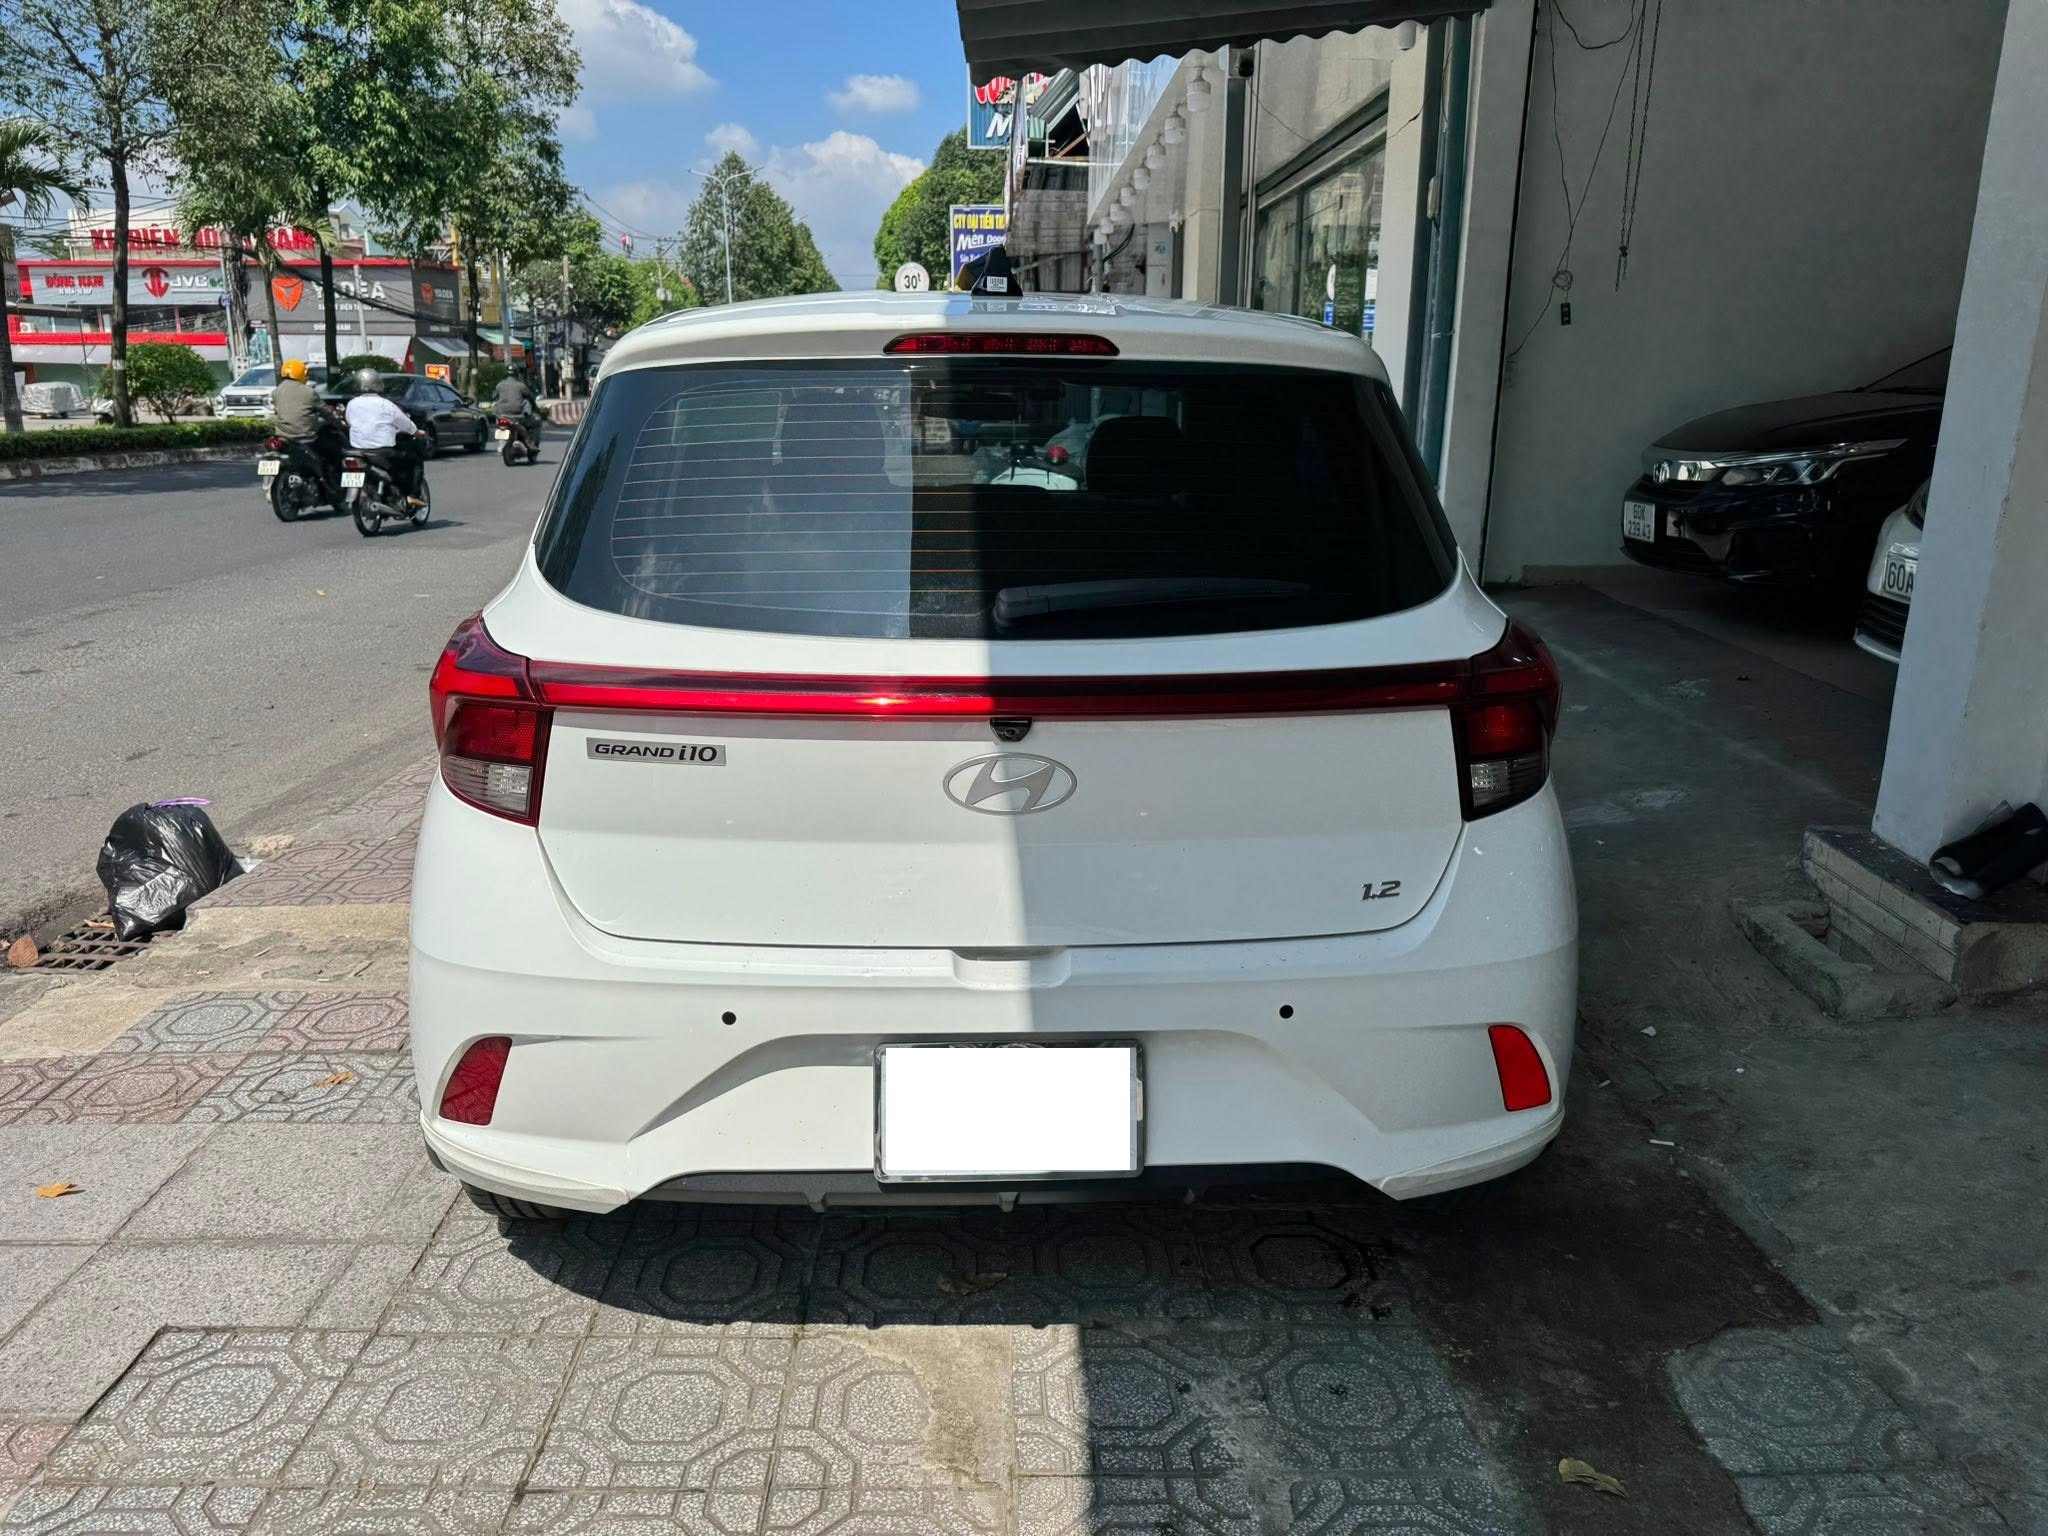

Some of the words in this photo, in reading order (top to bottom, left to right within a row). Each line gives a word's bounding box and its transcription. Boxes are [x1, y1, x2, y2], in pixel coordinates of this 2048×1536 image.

[311, 281, 387, 300] YDEA
[1888, 561, 1914, 593] 60A
[594, 743, 675, 758] GRAND
[678, 745, 718, 762] i10
[1362, 880, 1401, 900] 1.2
